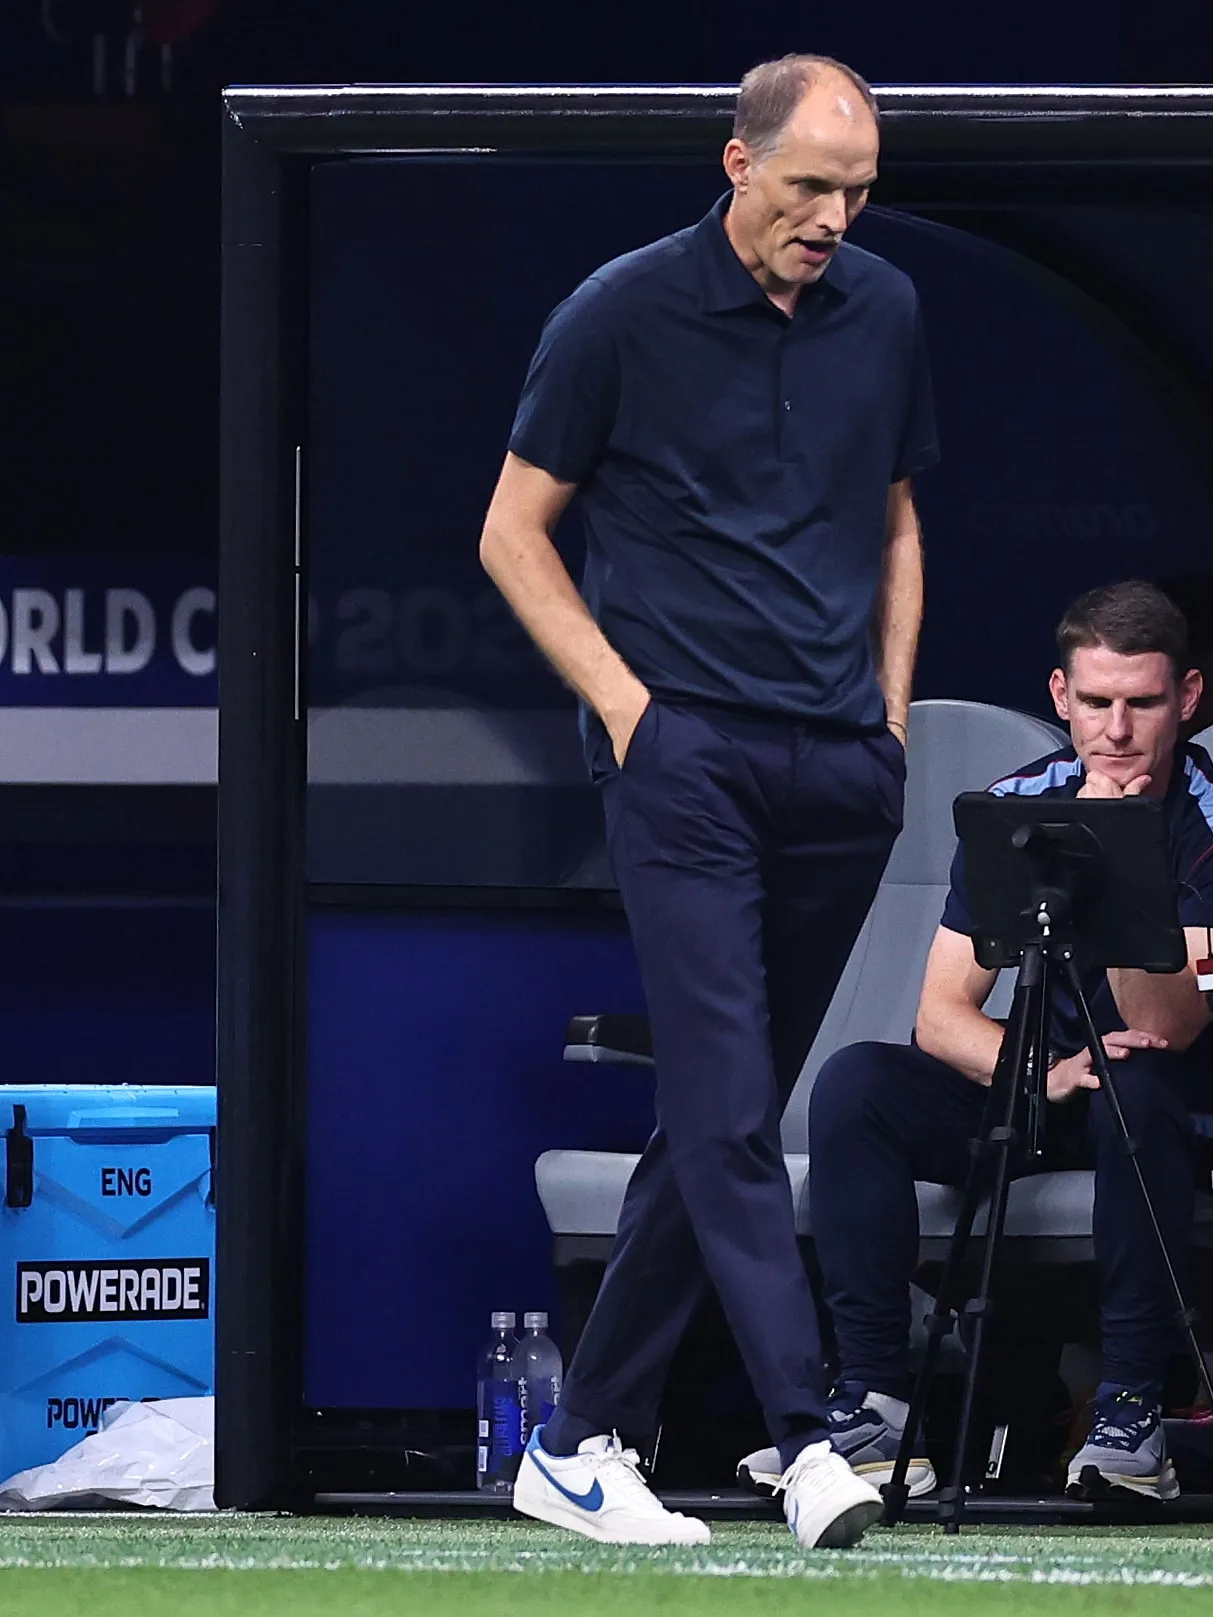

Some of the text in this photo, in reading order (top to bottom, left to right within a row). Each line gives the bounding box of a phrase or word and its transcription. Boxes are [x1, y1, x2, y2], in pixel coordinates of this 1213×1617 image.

[0, 587, 157, 675] RLD
[101, 1167, 151, 1197] ENG
[20, 1266, 201, 1314] POWERADE
